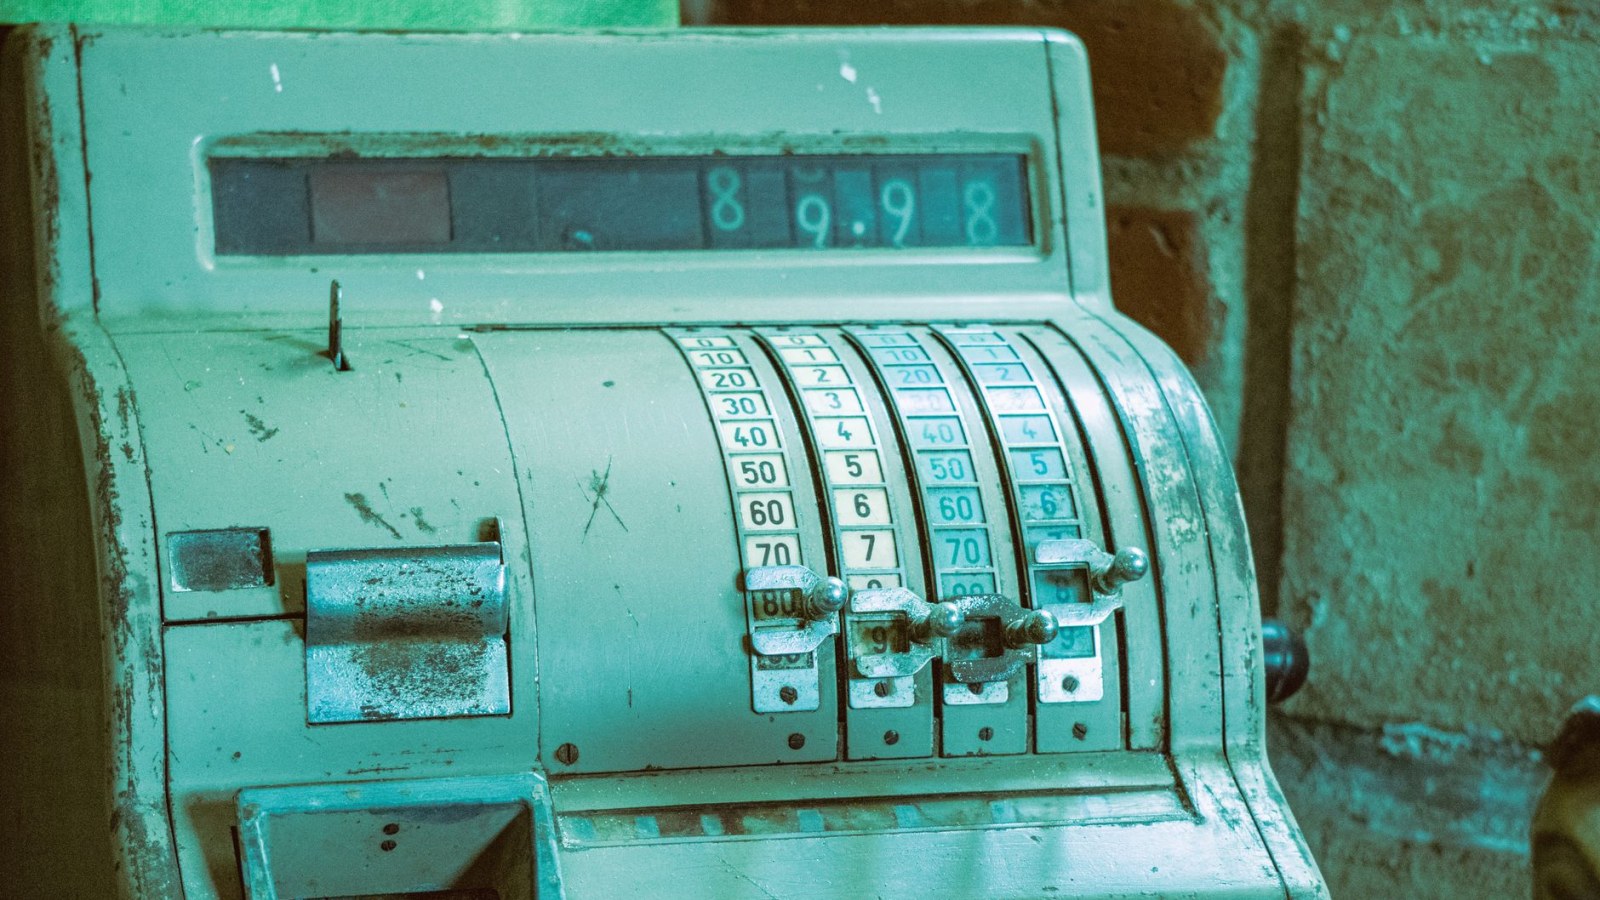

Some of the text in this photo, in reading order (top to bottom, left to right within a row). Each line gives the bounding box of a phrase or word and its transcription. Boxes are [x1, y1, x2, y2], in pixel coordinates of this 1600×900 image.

[700, 352, 734, 365] 10
[803, 349, 817, 361] 1
[885, 349, 919, 361] 10
[985, 347, 999, 360] 1
[711, 372, 746, 388] 20
[813, 368, 831, 383] 2
[897, 369, 931, 384] 20
[996, 367, 1015, 381] 2
[722, 396, 758, 415] 30
[825, 391, 842, 410] 3
[734, 426, 768, 447] 40
[837, 421, 852, 441] 4
[922, 422, 955, 443] 40
[1022, 420, 1037, 439] 4
[740, 460, 776, 484] 50
[845, 454, 862, 477] 5
[930, 457, 965, 480] 50
[1030, 452, 1048, 475] 5
[749, 499, 784, 526] 60
[854, 493, 871, 518] 6
[939, 495, 973, 521] 60
[1040, 490, 1057, 516] 6
[755, 542, 791, 567] 70
[860, 534, 875, 562] 7
[945, 537, 980, 565] 70
[763, 589, 797, 616] 80
[871, 625, 887, 654] 9
